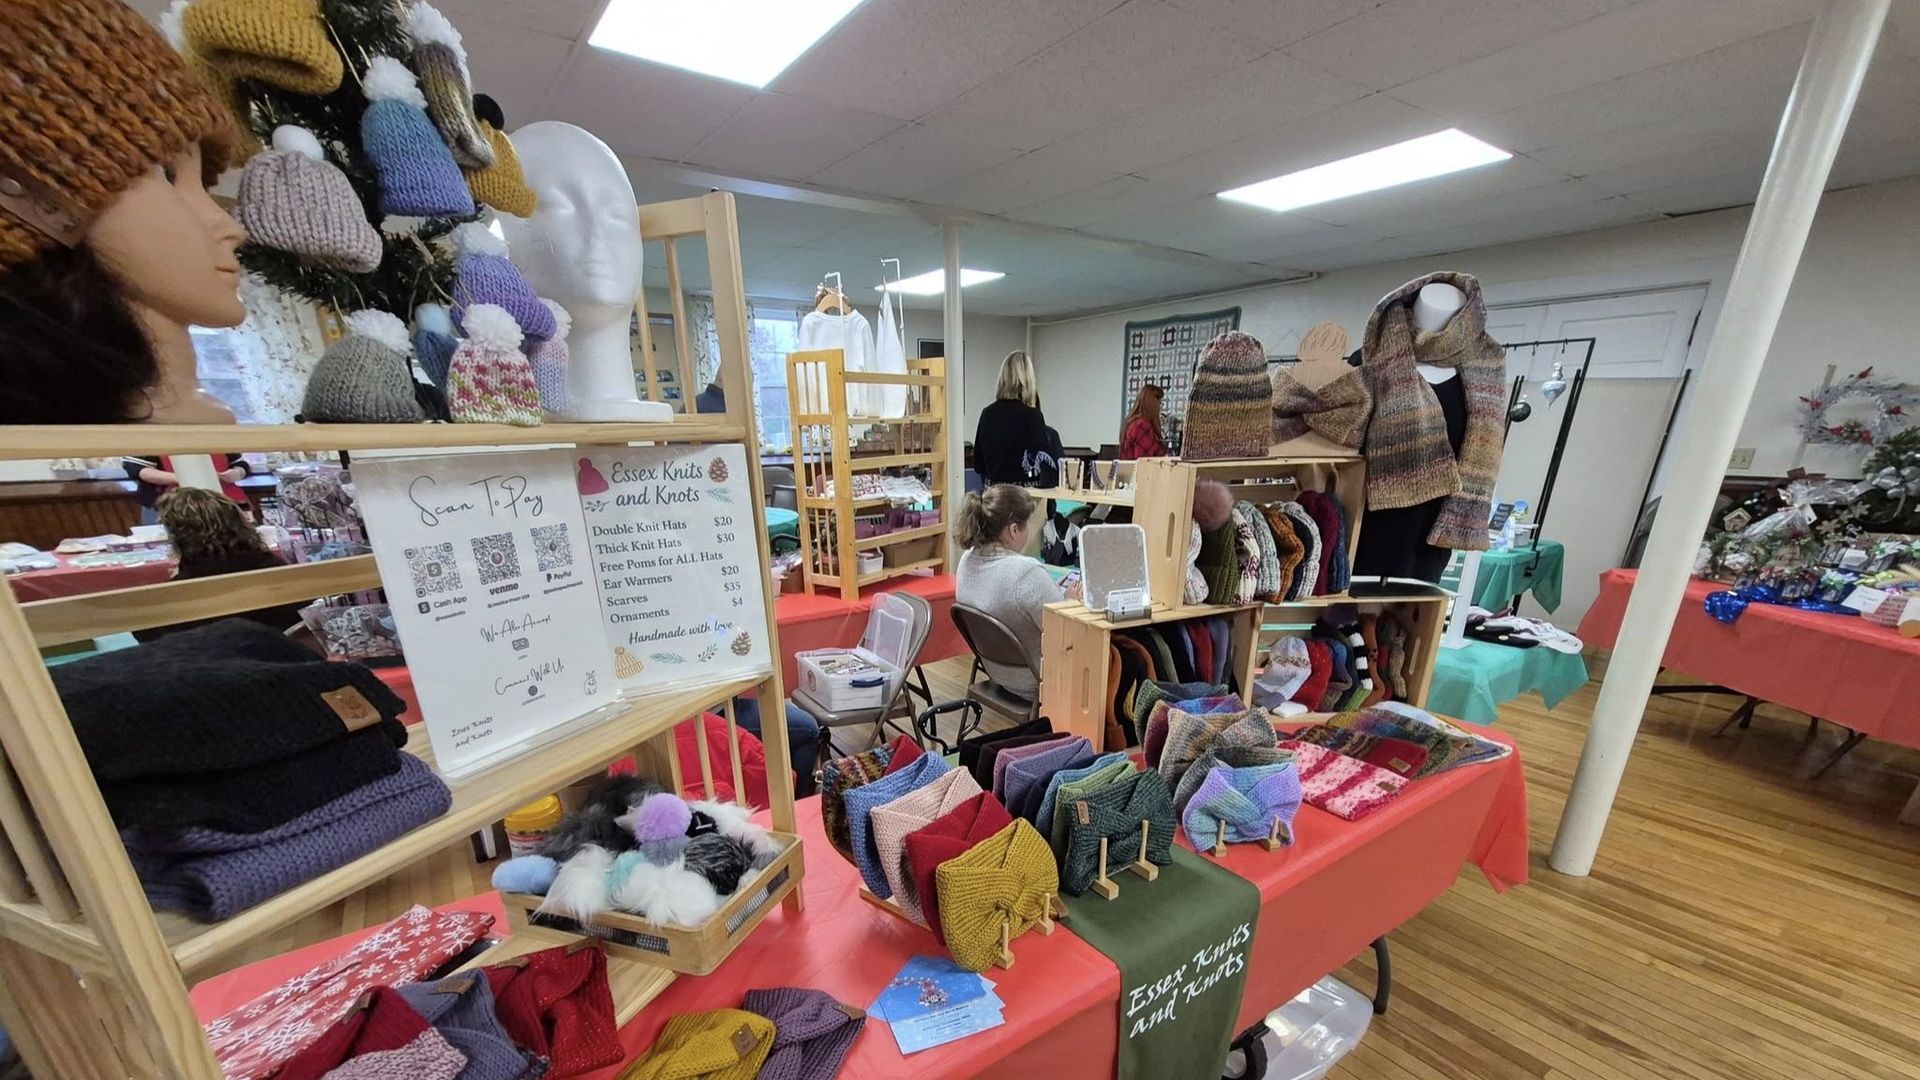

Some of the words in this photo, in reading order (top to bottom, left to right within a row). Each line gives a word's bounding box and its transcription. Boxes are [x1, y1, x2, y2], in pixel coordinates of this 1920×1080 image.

[612, 462, 658, 484] Essex
[663, 460, 703, 481] Knits
[409, 475, 474, 526] Scan
[469, 476, 502, 517] To
[501, 475, 543, 517] Pay
[616, 487, 651, 507] and
[656, 485, 700, 505] Knots
[592, 522, 634, 537] Double
[636, 520, 660, 534] Knit
[662, 519, 687, 531] Hats
[714, 515, 733, 527] $20
[595, 541, 630, 555] Thick
[631, 538, 655, 552] Knit
[657, 537, 682, 550] Hats
[716, 532, 735, 544] $30
[599, 560, 624, 573] Free
[626, 557, 657, 571] Poms
[658, 554, 674, 567] for
[676, 552, 698, 565] ALL
[700, 550, 724, 563] Hats
[489, 582, 519, 596] venmo
[603, 577, 622, 591] Ear
[623, 573, 673, 588] Warmers
[720, 565, 740, 577] $20
[434, 599, 452, 608] Cash
[453, 596, 468, 604] App
[606, 593, 649, 608] Scarves
[723, 581, 742, 593] $35
[609, 607, 671, 625] Ornaments
[732, 597, 744, 608] $4
[629, 624, 687, 646] Handmade
[688, 621, 713, 636] with
[714, 619, 734, 632] love
[455, 736, 470, 748] and
[1126, 964, 1188, 1019] Essex
[1192, 922, 1251, 973] Knits
[1129, 988, 1179, 1039] and
[1182, 952, 1244, 1005] Knots
